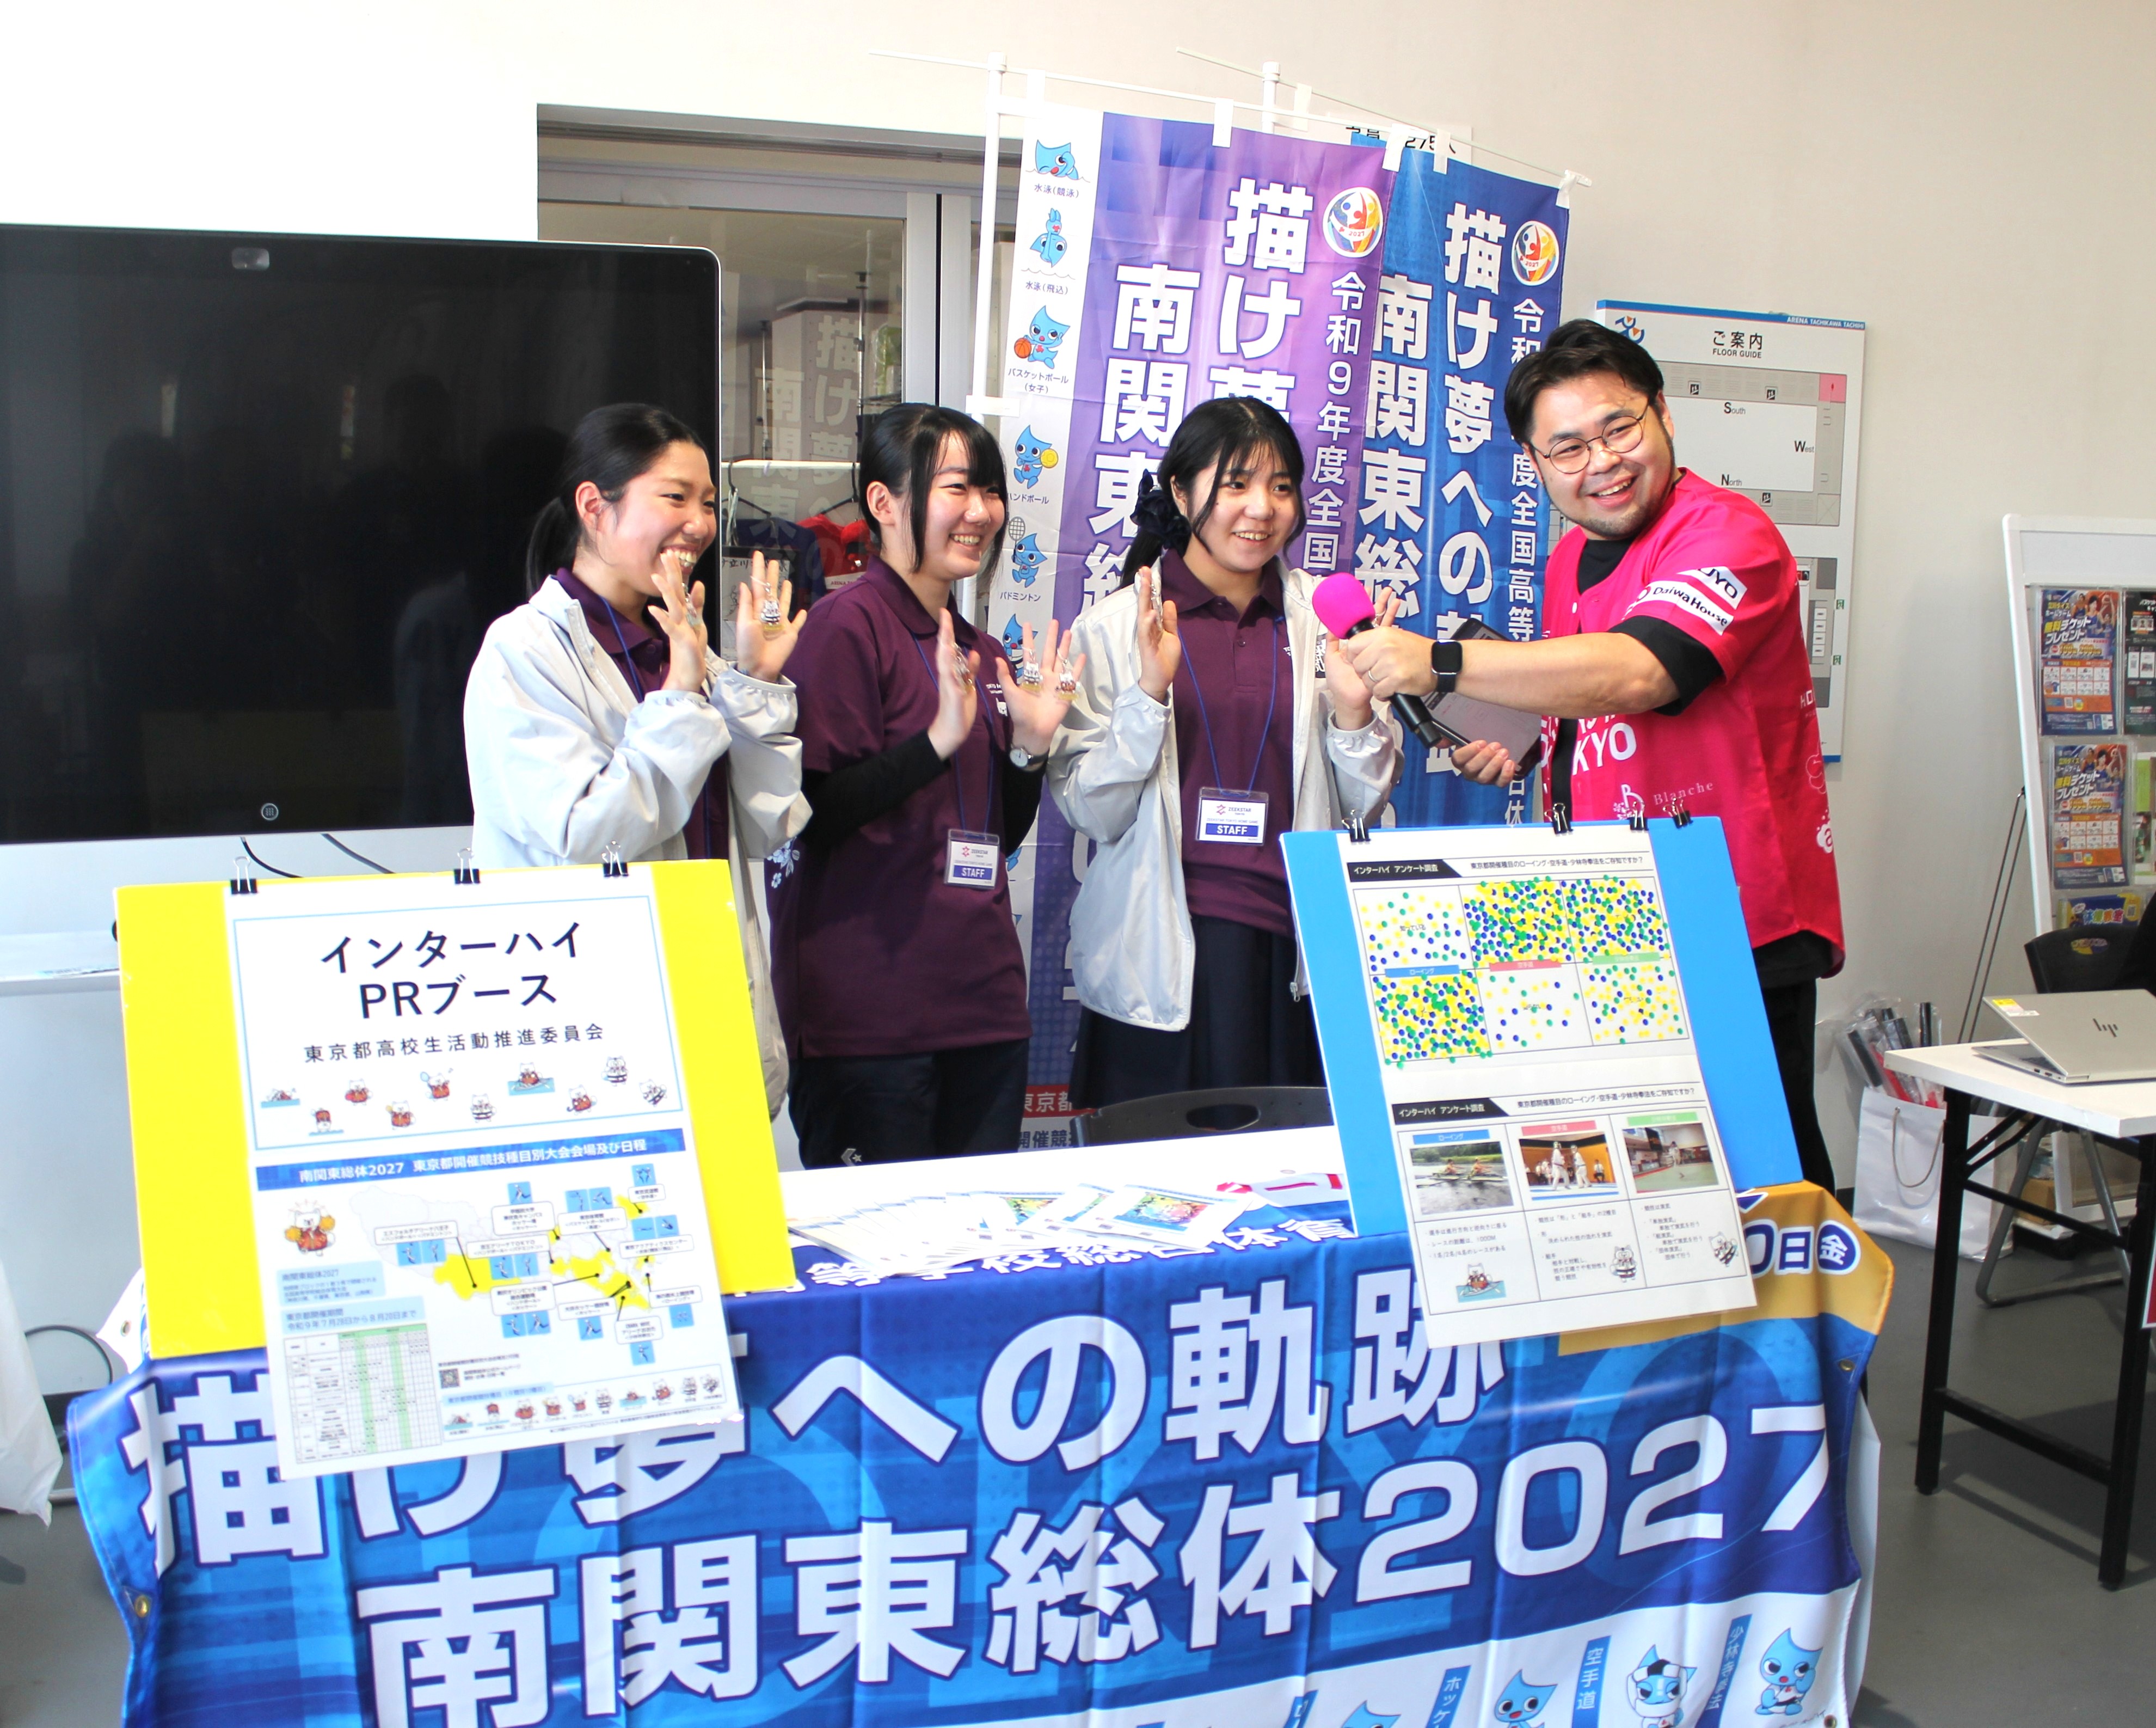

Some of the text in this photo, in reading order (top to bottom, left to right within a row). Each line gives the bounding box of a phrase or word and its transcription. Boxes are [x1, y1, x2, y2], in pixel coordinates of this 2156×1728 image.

[1034, 183, 1079, 199] 水泳(競泳)
[1025, 280, 1068, 295] 水泳(飛込)
[1787, 316, 1864, 330] ARENA TACHIKAWA TACHIHI
[1713, 331, 1763, 350] ご案内
[1712, 348, 1761, 359] FLOOR GUIDE
[1008, 368, 1069, 384] バスケットボール
[1024, 383, 1049, 395] (女子)
[1724, 402, 1746, 415] South
[1794, 440, 1815, 454] West
[1721, 474, 1742, 487] North
[1000, 591, 1041, 602] バドミントン
[1653, 586, 1728, 626] Daiwa House
[1654, 781, 1713, 806] Blanche
[1217, 825, 1248, 835] STAFF
[961, 867, 985, 878] STAFF
[1354, 864, 1439, 875] インターハイ アンケート調査
[1400, 923, 1427, 932] 知っている
[321, 922, 581, 975] インターハイ
[1409, 967, 1435, 976] ローイング
[359, 973, 557, 1019] PRブース
[304, 1022, 604, 1063] 東京都高校生活動推進委員会
[1399, 1104, 1485, 1118] インターハイ アンケート調査
[1438, 1133, 1464, 1141] ローイング
[299, 1162, 404, 1184] 南関東総体2027
[357, 1402, 1829, 1728] 南関東総体2027
[1576, 1646, 1604, 1710] 空手道
[1433, 1676, 1463, 1728] ホッケ
